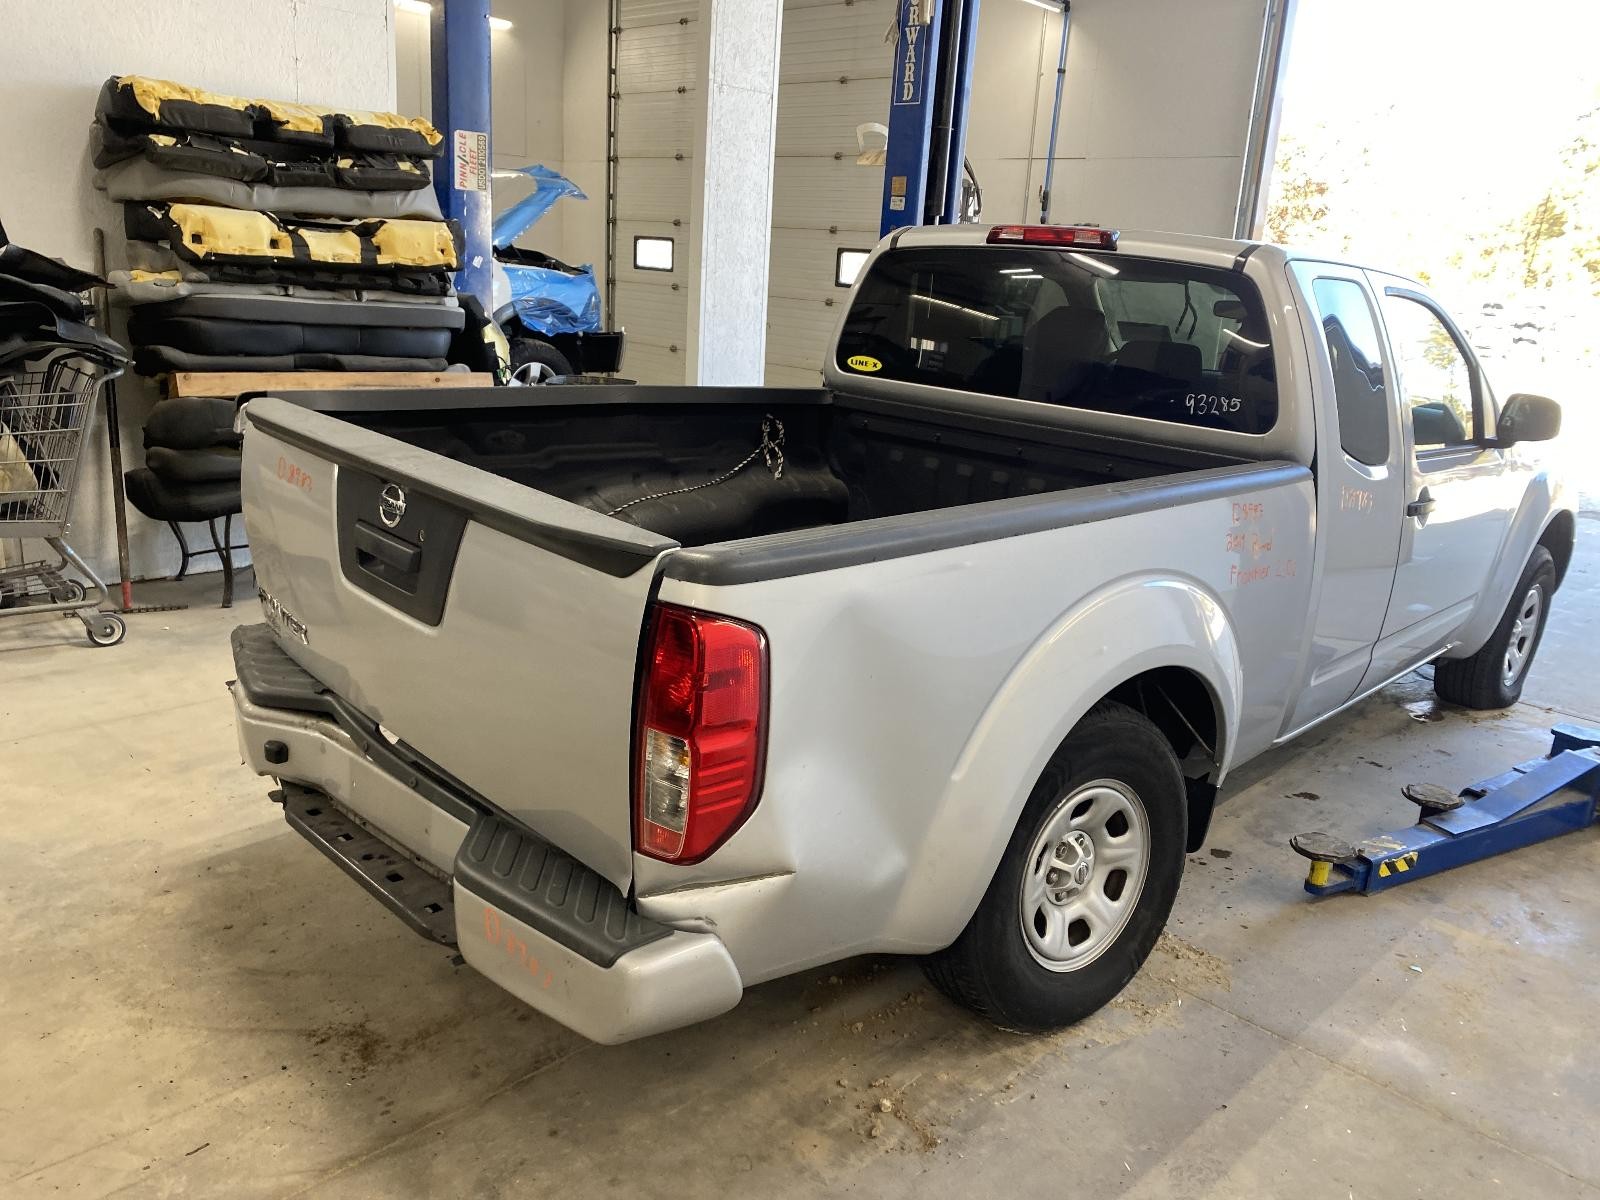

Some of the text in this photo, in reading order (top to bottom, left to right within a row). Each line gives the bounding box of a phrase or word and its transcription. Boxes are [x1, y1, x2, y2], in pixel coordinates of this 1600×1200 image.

[903, 0, 920, 101] RWARD
[457, 132, 469, 188] PINNACLE
[469, 148, 477, 175] FLEET
[478, 166, 486, 189] USDOT
[1186, 393, 1242, 415] 93285
